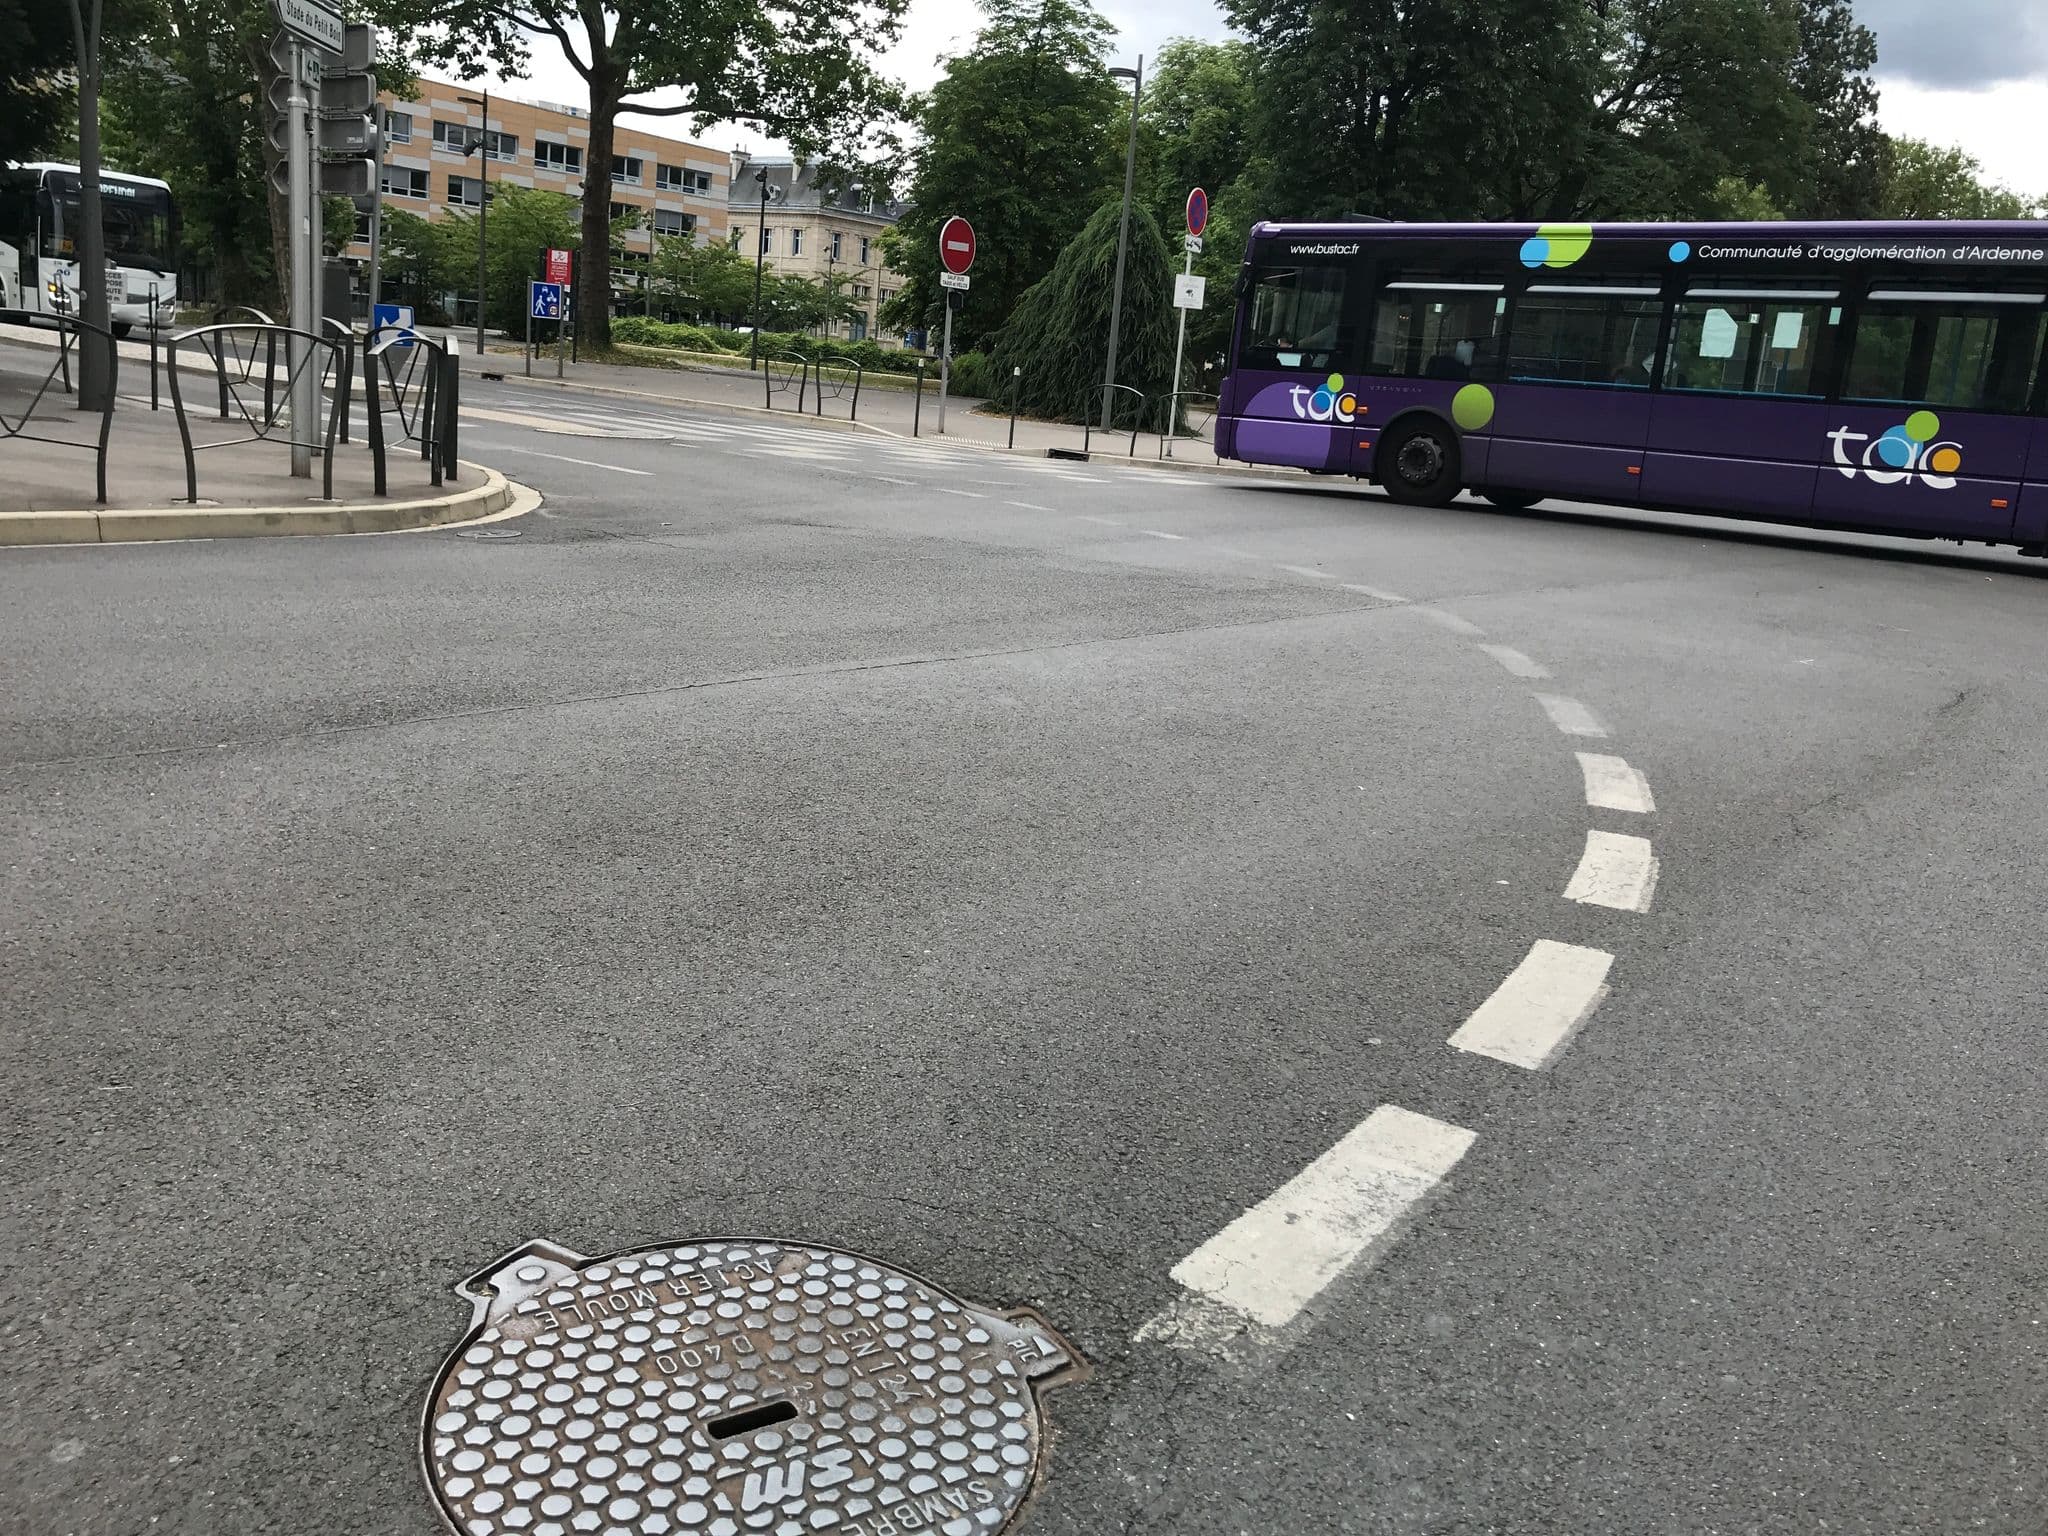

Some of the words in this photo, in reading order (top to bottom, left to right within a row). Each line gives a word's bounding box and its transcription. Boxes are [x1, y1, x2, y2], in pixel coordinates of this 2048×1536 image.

[286, 0, 304, 22] Stade
[305, 11, 313, 27] du
[314, 14, 328, 37] Petit
[1290, 243, 1360, 255] www.bustac.fr
[1698, 244, 1802, 258] Communauté
[1807, 244, 1946, 262] d'agglomération
[1952, 245, 2044, 260] d'Ardenne
[1289, 384, 1357, 422] tac
[1826, 425, 1963, 490] tac
[668, 1258, 774, 1296] ACIER
[535, 1287, 658, 1330] MOULE
[655, 1344, 721, 1374] 400
